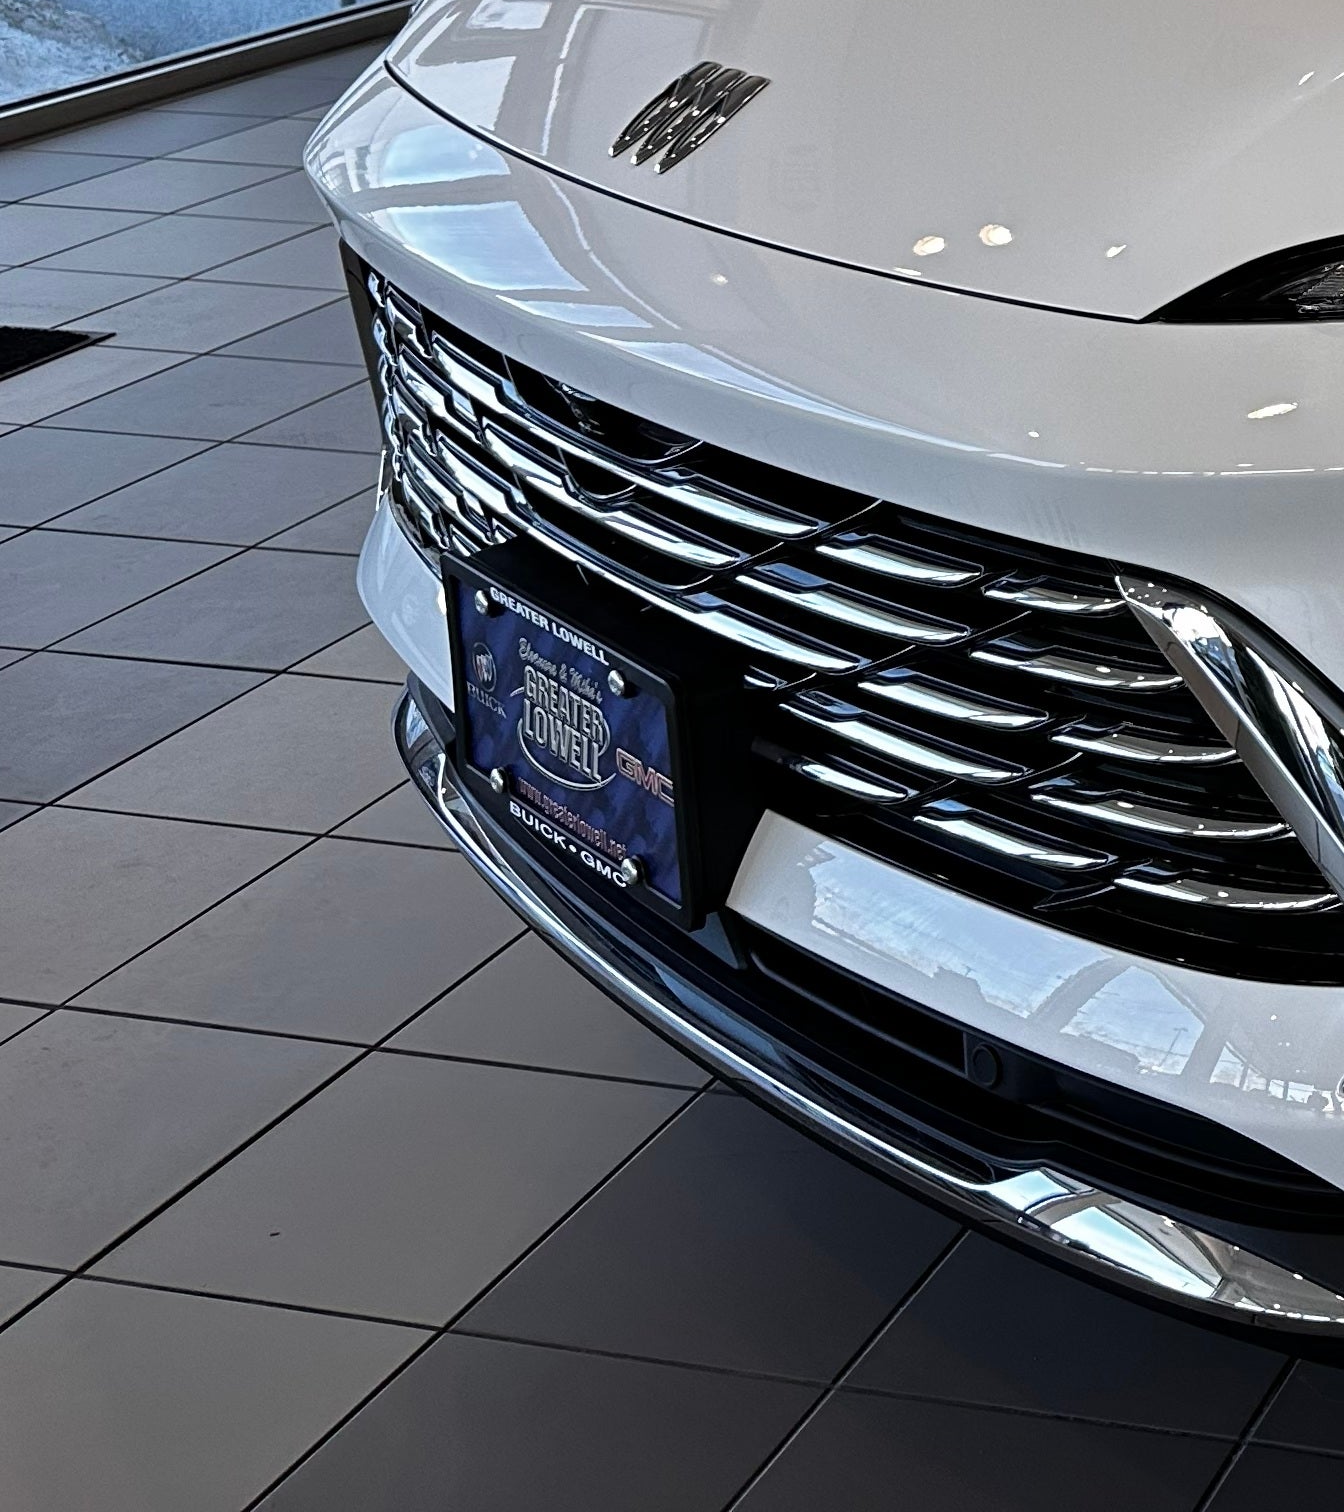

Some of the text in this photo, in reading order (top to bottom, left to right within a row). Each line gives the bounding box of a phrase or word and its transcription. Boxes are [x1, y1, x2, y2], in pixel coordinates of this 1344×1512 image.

[489, 586, 550, 632] GREATER
[551, 622, 610, 667] LOWELL
[466, 680, 508, 720] BUICK
[523, 698, 602, 783] LOWELL
[524, 665, 604, 747] GREATER
[616, 747, 675, 808] GMC
